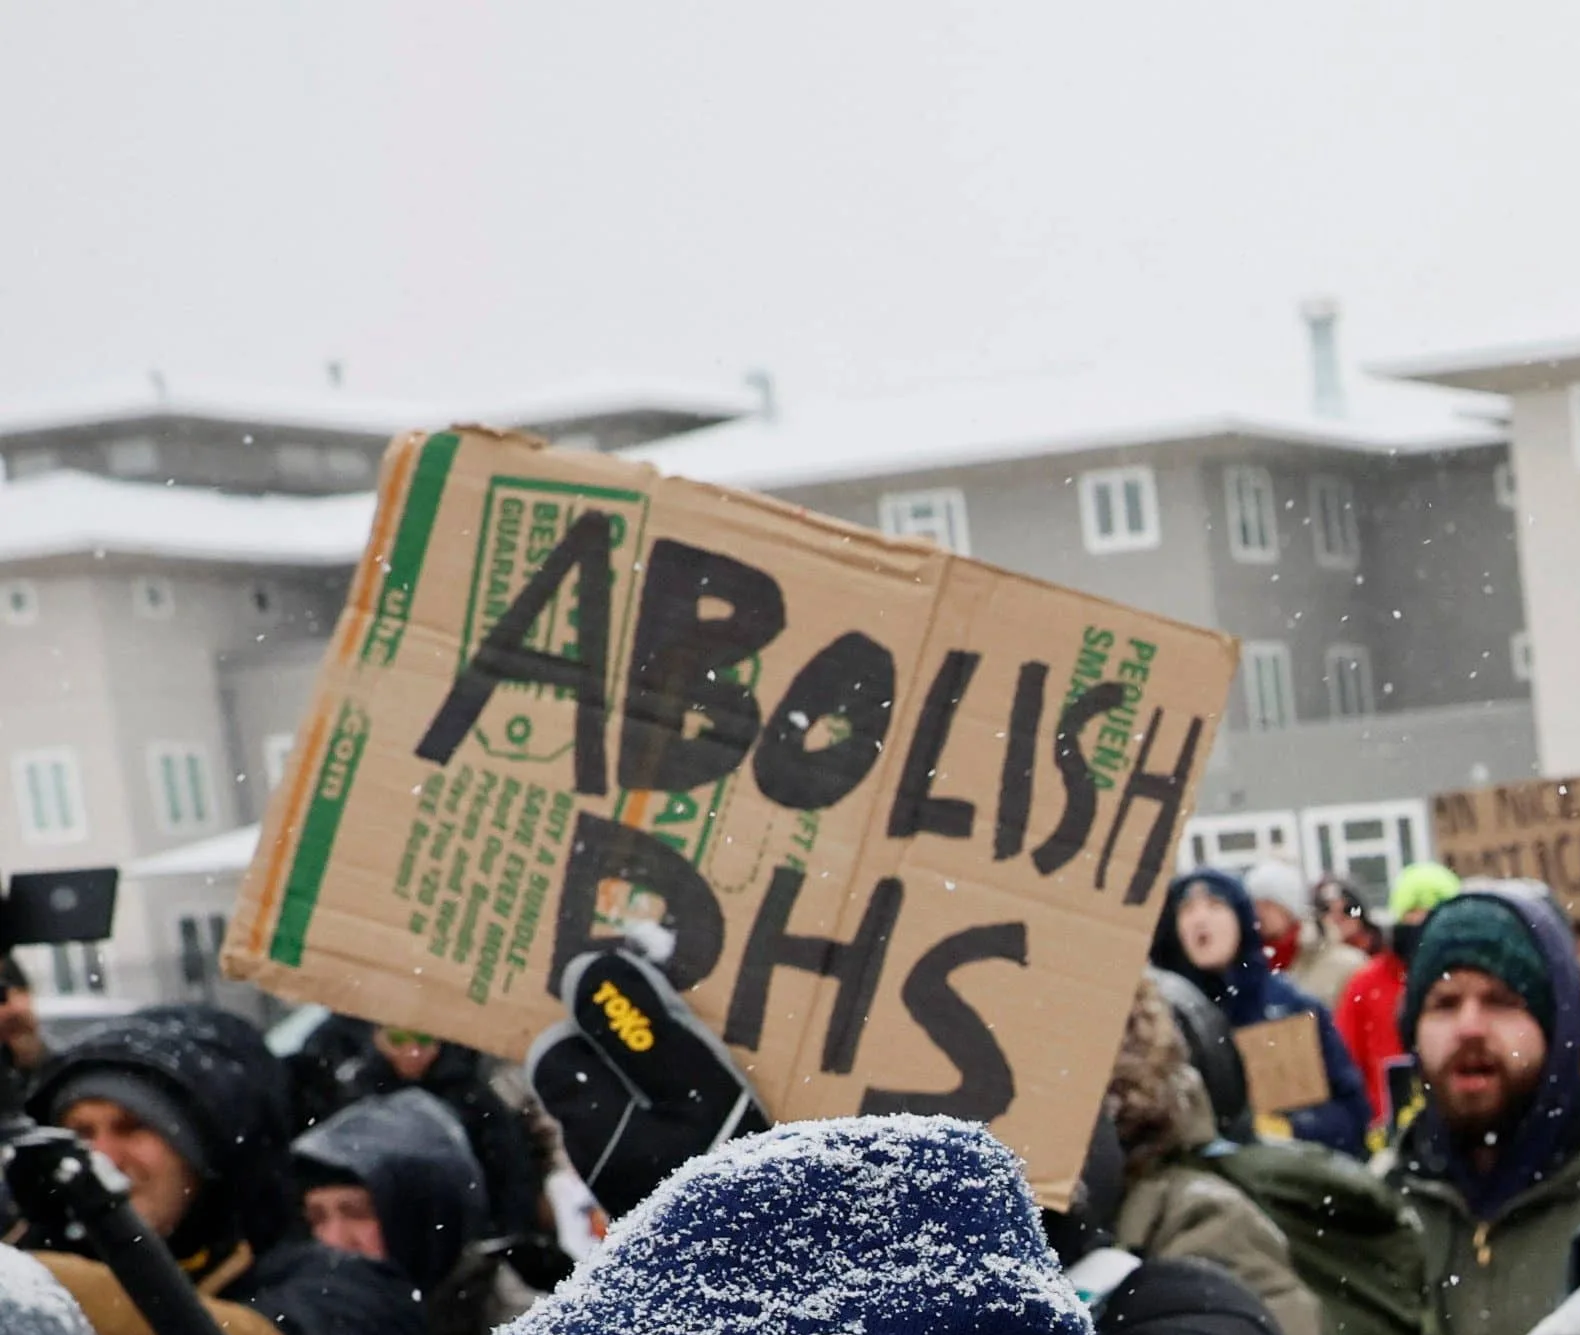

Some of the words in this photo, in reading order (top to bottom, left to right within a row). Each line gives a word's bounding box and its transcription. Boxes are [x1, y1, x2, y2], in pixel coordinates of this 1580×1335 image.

[481, 497, 523, 640] GUARAN
[413, 509, 1203, 905] ABOLISH
[1062, 626, 1116, 715] SMA
[514, 784, 546, 846] SAVE
[494, 853, 526, 917] EVEN
[537, 846, 556, 865] A
[548, 810, 1027, 1124] DHS
[593, 980, 654, 1052] TOKO
